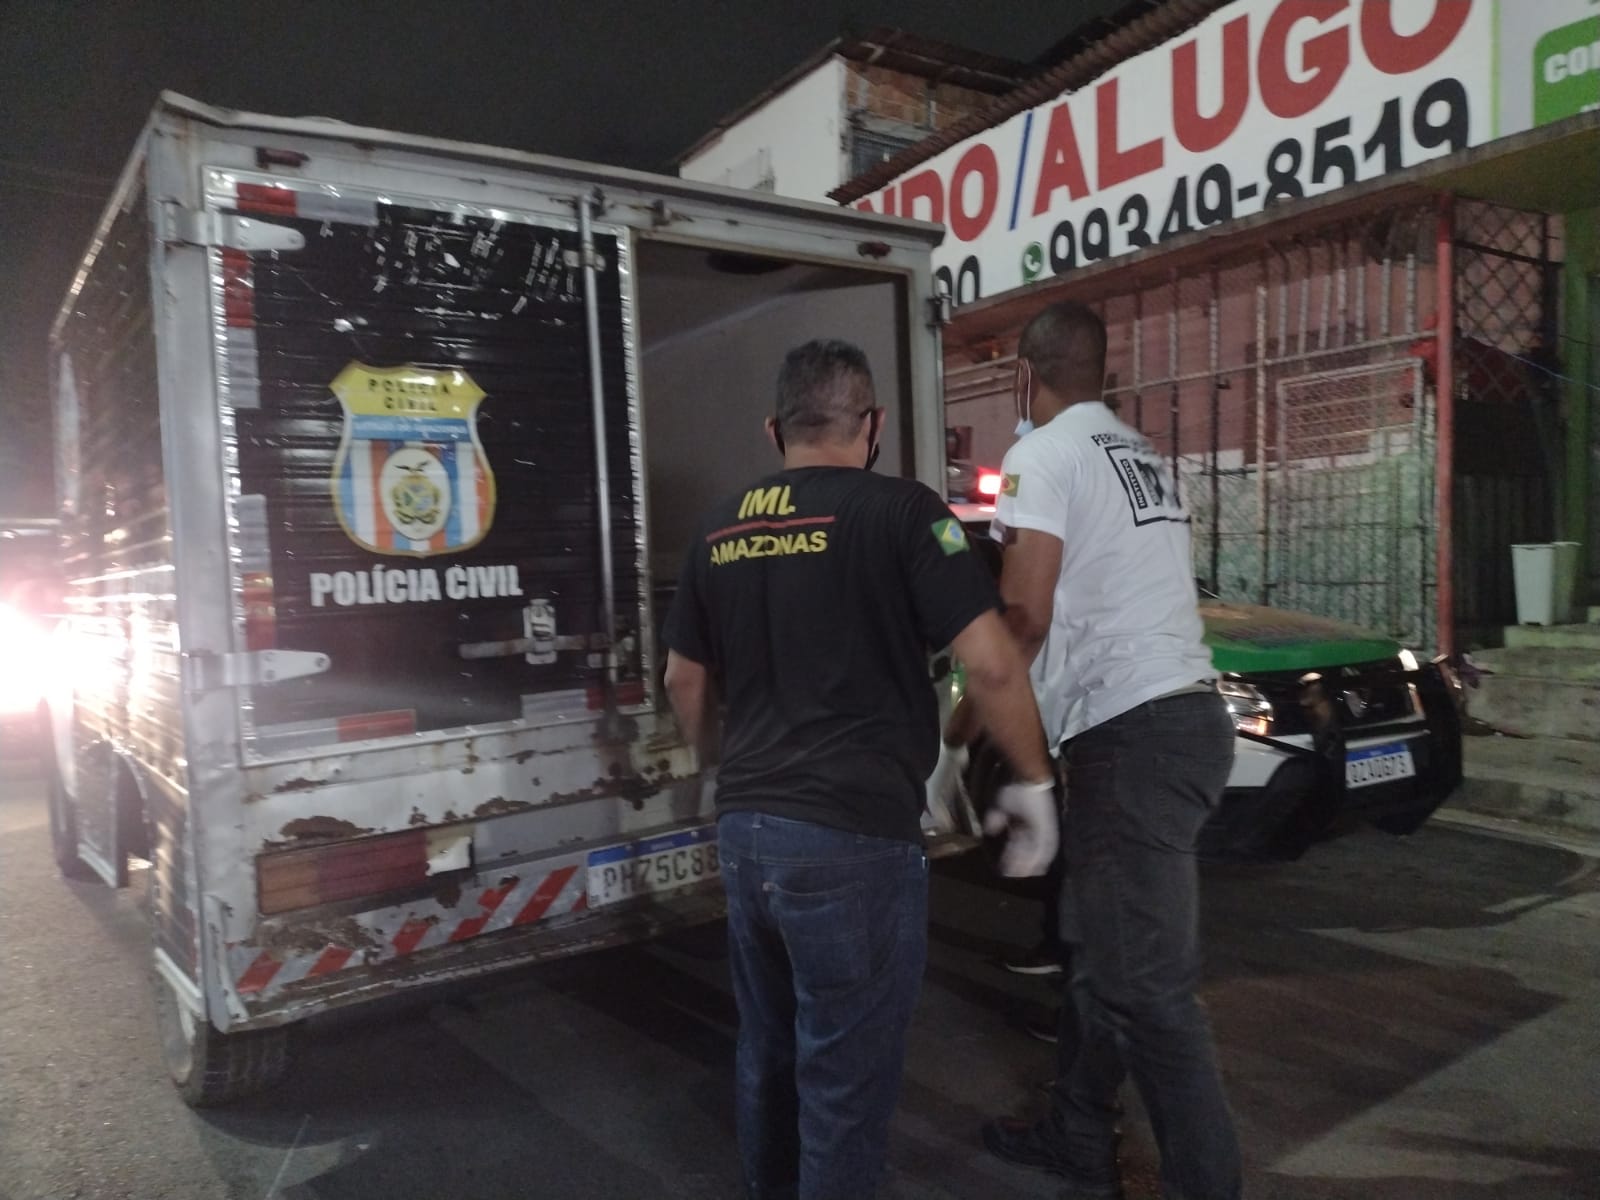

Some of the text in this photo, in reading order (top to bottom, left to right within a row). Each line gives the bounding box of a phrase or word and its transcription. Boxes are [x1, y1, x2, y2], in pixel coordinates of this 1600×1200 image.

[737, 485, 796, 520] IML
[709, 531, 828, 566] AMAZONAS
[309, 563, 524, 607] POLÍCIA CIVIL
